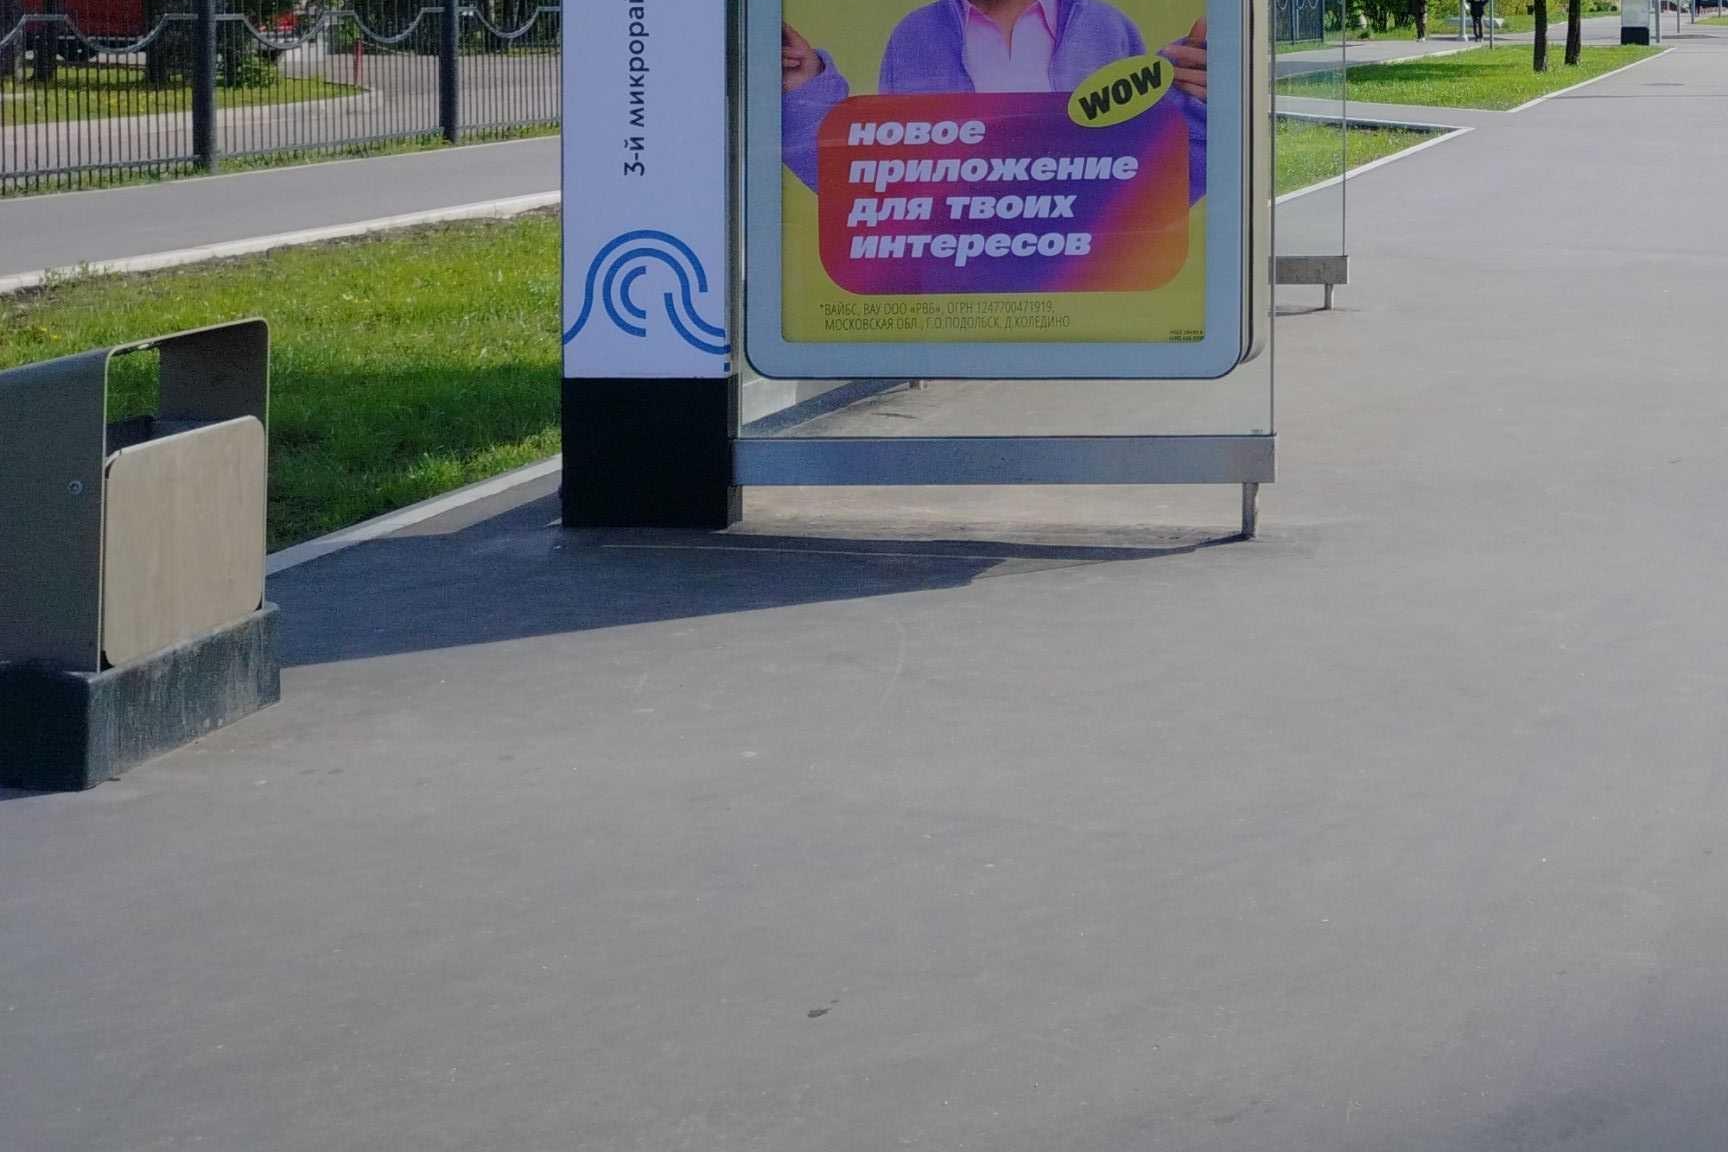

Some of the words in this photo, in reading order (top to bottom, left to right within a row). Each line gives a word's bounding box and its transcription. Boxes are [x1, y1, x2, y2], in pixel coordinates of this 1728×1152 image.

[848, 120, 986, 146] новое
[623, 136, 647, 177] 3-й
[849, 155, 1139, 192] приложение
[848, 197, 934, 227] для
[945, 194, 1077, 220] твоих
[849, 232, 1092, 267] интересов
[825, 318, 893, 330] МОСКОВСКАЯ
